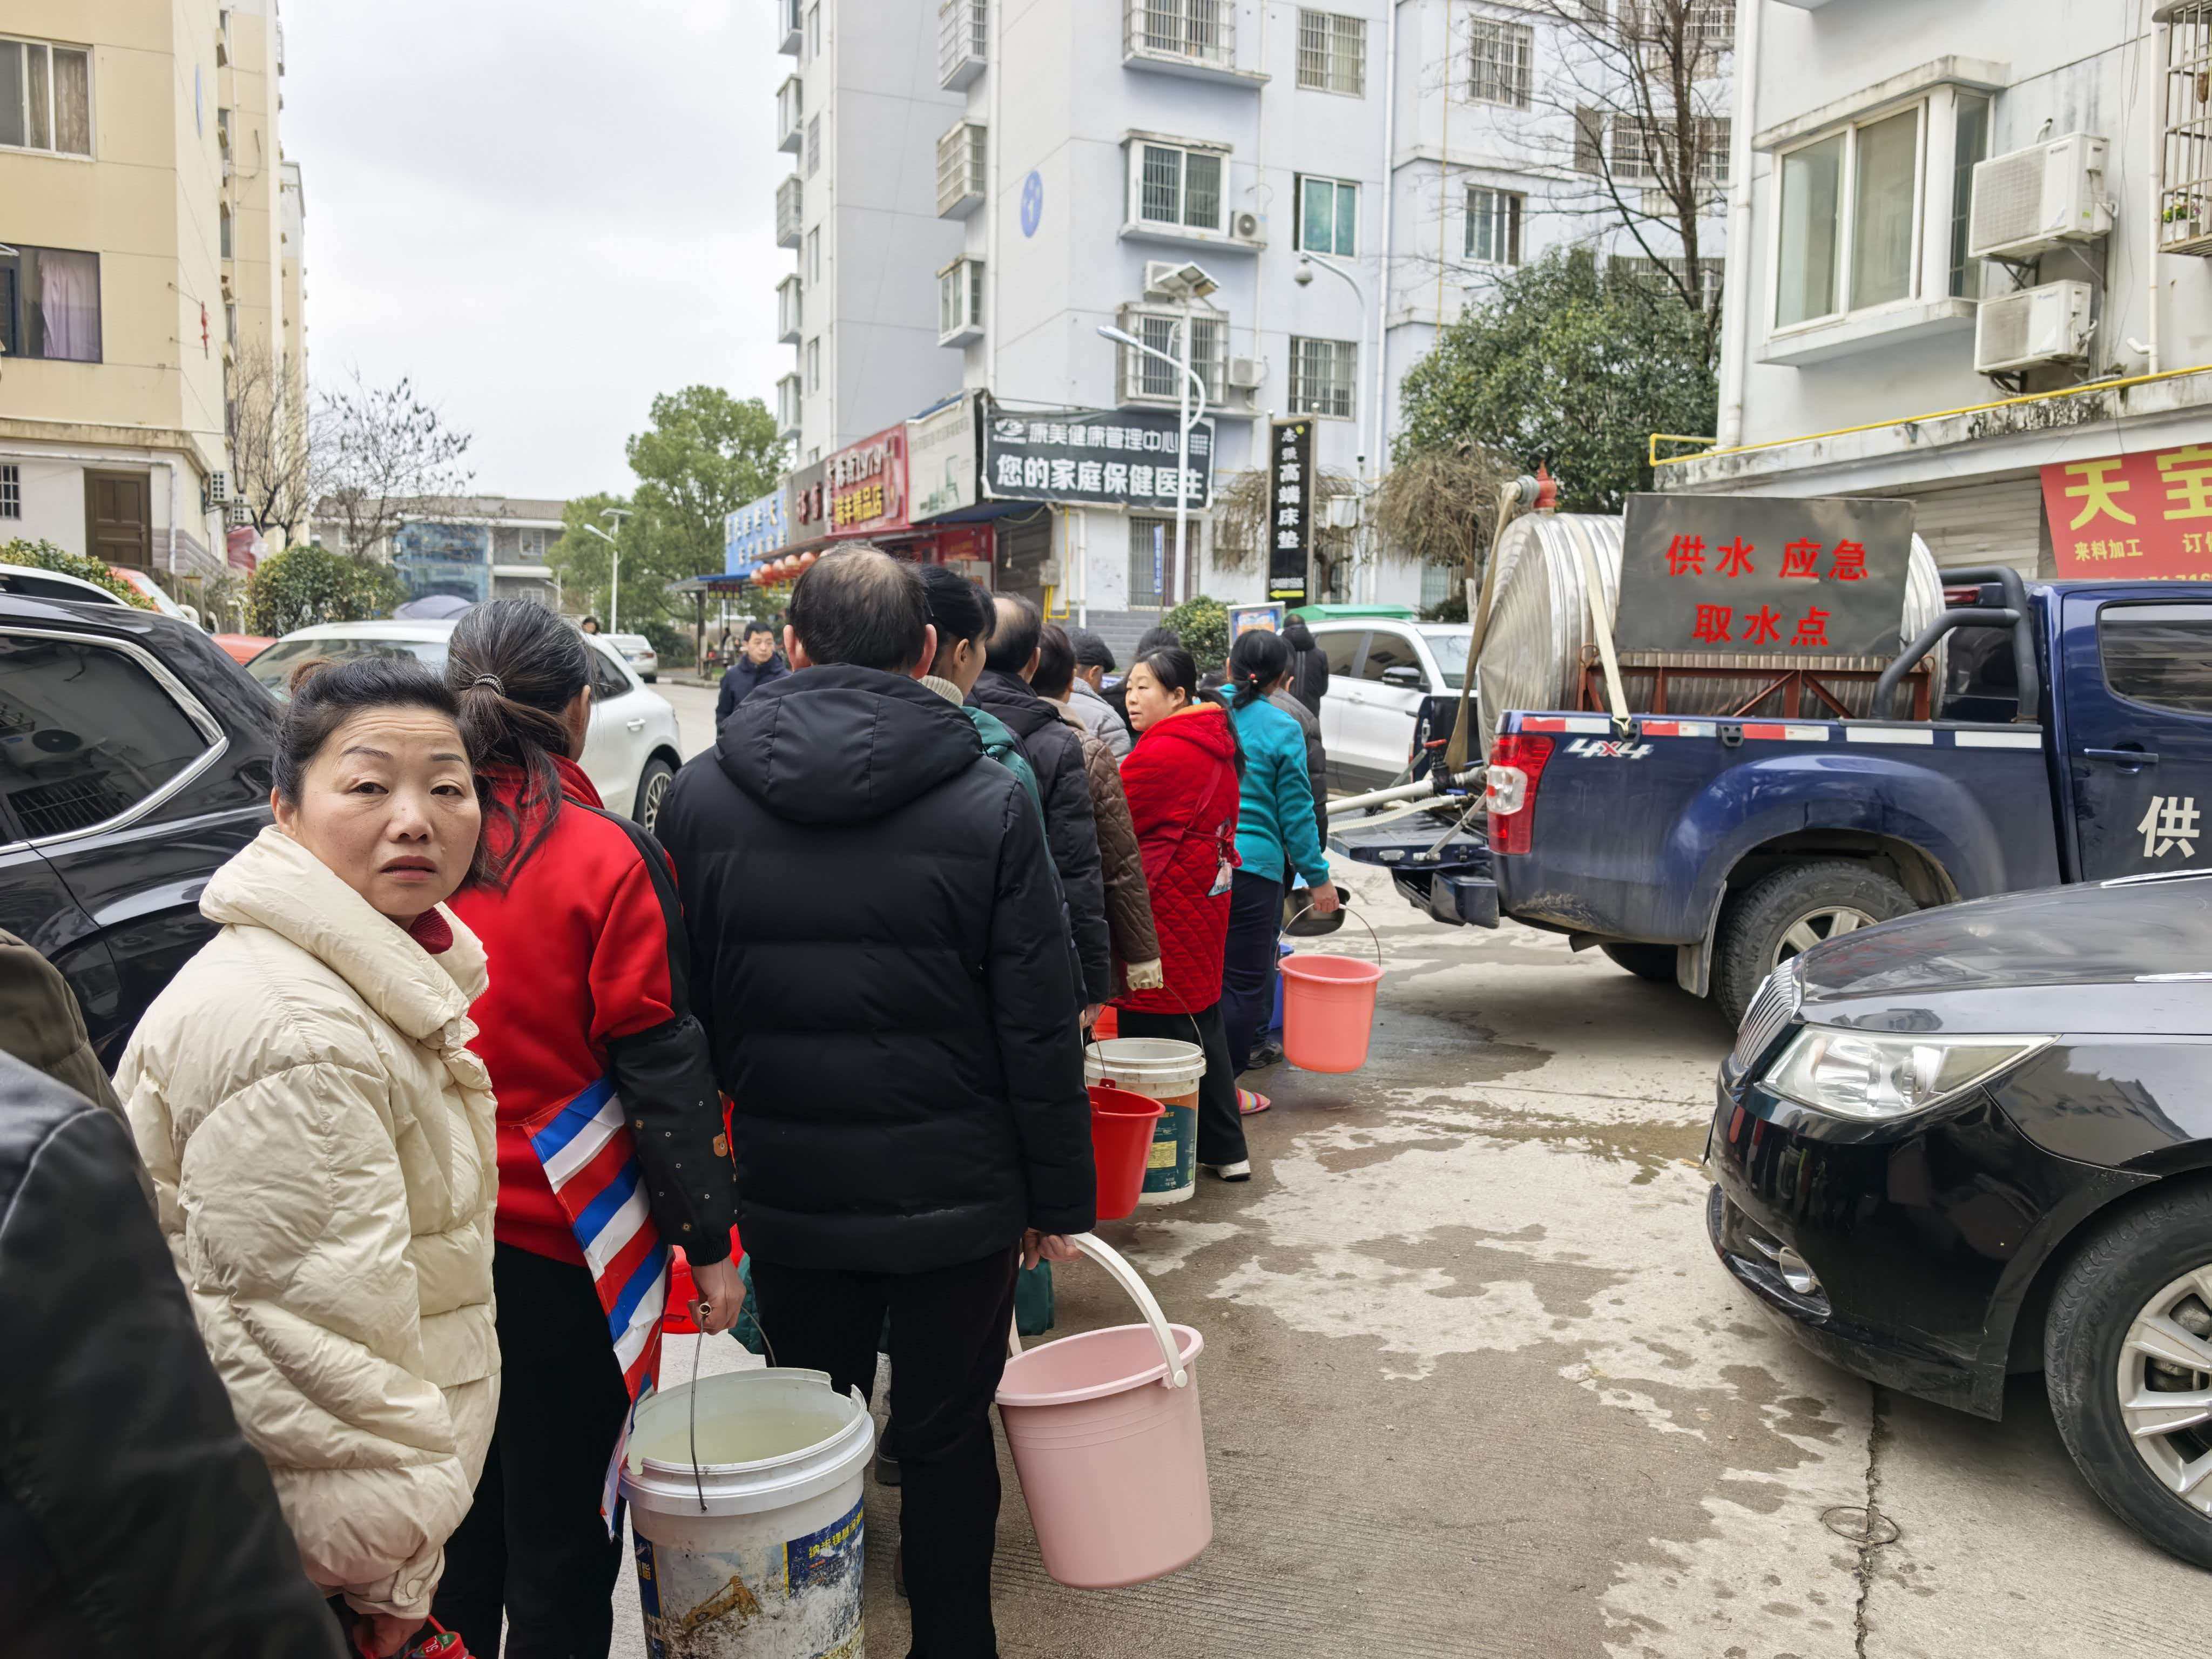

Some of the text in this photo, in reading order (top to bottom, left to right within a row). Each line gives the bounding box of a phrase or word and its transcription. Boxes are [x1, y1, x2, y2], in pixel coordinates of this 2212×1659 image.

[1665, 534, 1869, 581] 供水 应急
[2074, 539, 2143, 561] 来料加工
[1691, 604, 1832, 646] 取水点
[2136, 795, 2200, 858] 供
